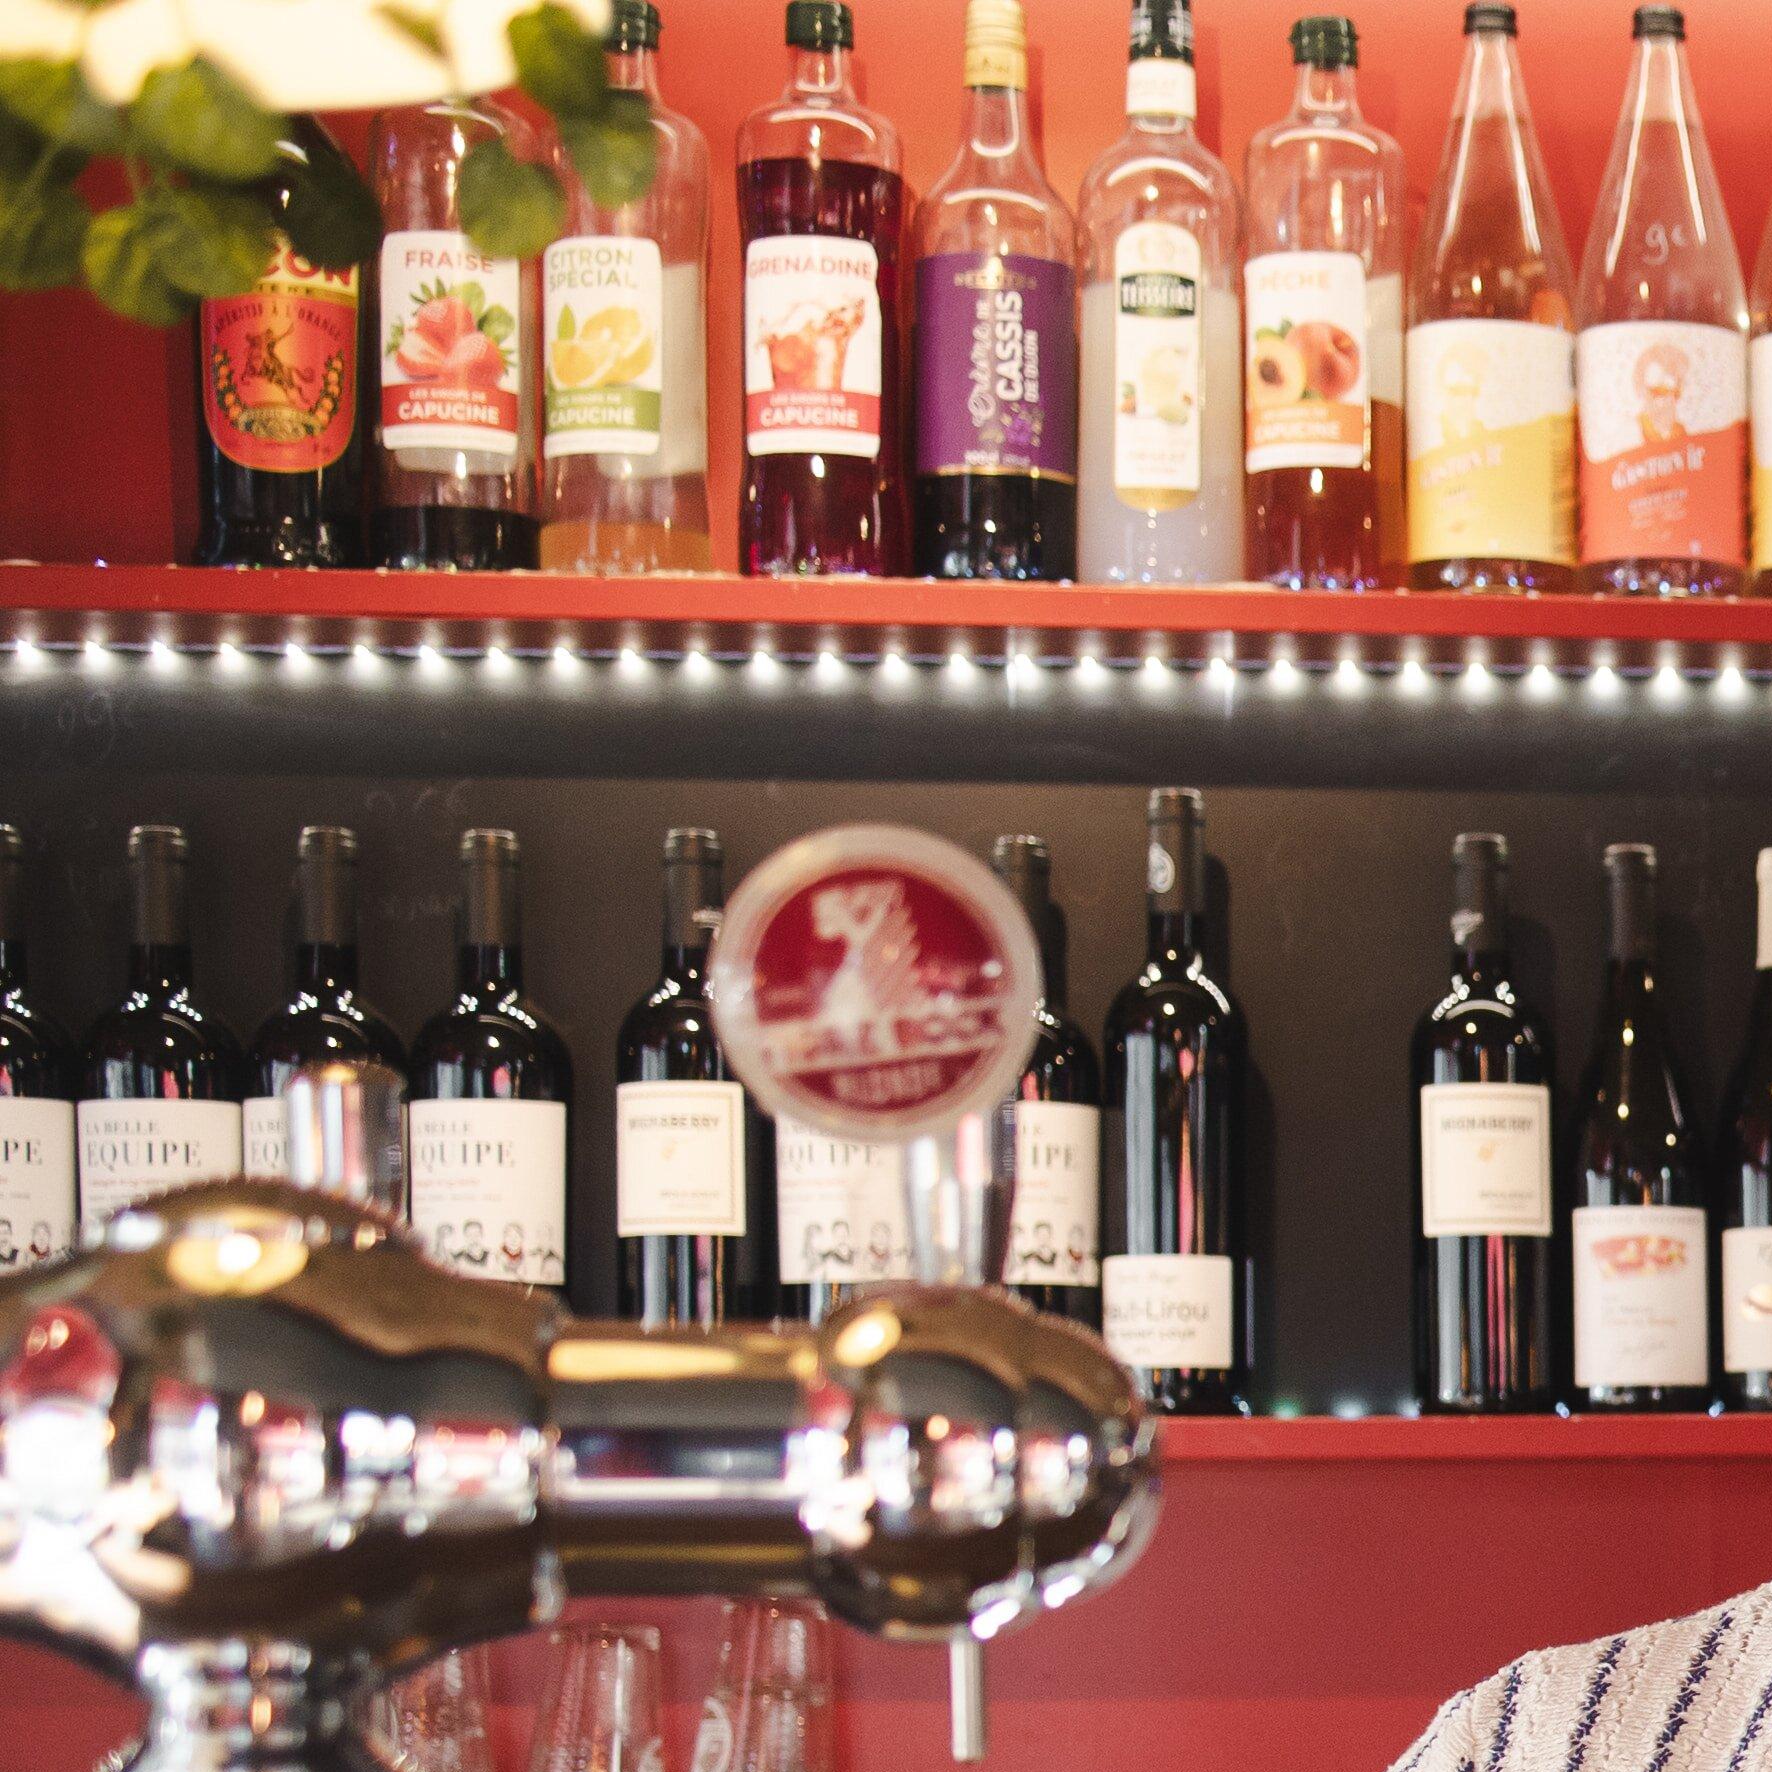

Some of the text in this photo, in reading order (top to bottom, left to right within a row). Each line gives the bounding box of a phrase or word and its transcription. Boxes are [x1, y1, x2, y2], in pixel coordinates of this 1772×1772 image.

[404, 250, 495, 275] FRAISE
[550, 245, 634, 270] CITRON
[749, 254, 878, 281] GRENADINE
[995, 290, 1024, 402] CASSIS
[398, 401, 501, 426] CAPUCINE
[550, 406, 637, 427] CAPUCINE
[760, 405, 860, 429] CAPUCINE
[86, 1139, 202, 1173] EQUIPE
